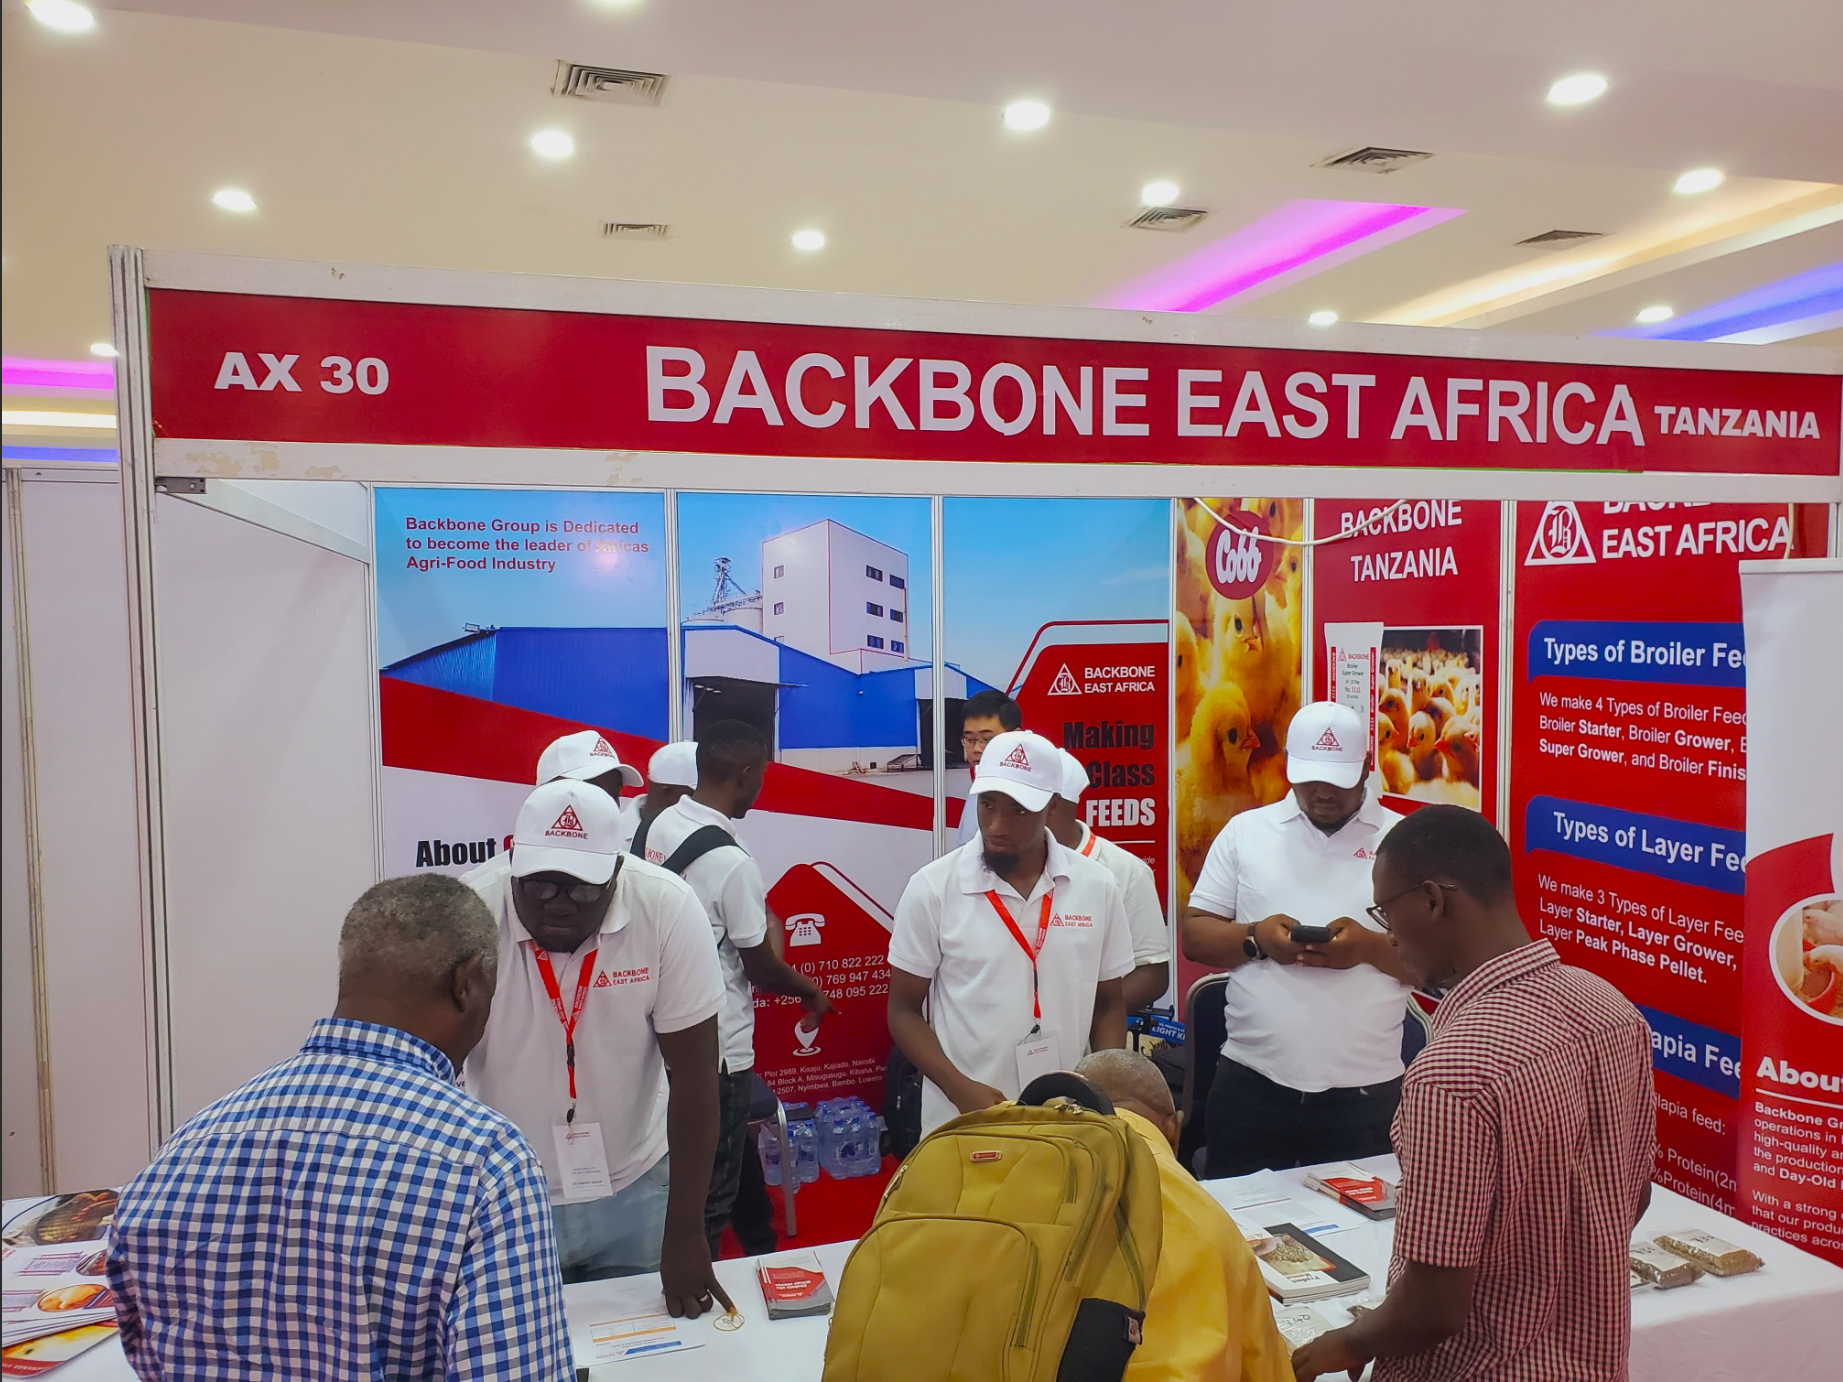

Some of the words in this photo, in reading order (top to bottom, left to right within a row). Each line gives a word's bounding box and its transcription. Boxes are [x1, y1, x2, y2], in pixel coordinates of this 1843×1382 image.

[213, 352, 302, 393] AX
[320, 356, 390, 396] 30
[646, 345, 1150, 437] BACKBONE
[1178, 368, 1376, 440] EAST
[1390, 376, 1646, 447] AFRICA
[1654, 405, 1821, 440] TANZANIA
[405, 517, 486, 532] Backbone
[491, 519, 541, 535] Group
[545, 520, 559, 534] is
[563, 520, 640, 535] Dedicated
[1340, 500, 1463, 538] BACKBONE
[406, 537, 422, 550] to
[427, 537, 491, 551] become
[495, 538, 519, 551] the
[525, 539, 573, 552] leader
[577, 540, 592, 552] of
[1602, 525, 1673, 559] EAST
[1675, 516, 1795, 556] AFRICA
[406, 556, 488, 572] Agri-Food
[492, 557, 557, 573] Industry
[1215, 526, 1262, 584] Cobb
[1350, 546, 1459, 583] TANZANIA
[1543, 637, 1599, 666] Types
[1604, 639, 1626, 663] of
[1630, 639, 1706, 667] Broiler
[1084, 665, 1156, 680] BACKBONE
[1084, 683, 1113, 694] EAST
[1114, 681, 1156, 693] AFRICA
[1539, 692, 1559, 708] We
[1561, 696, 1593, 711] make
[1595, 697, 1604, 711] 4
[1606, 697, 1645, 717] Types
[1647, 701, 1662, 717] of
[1663, 702, 1709, 722] Broiler
[1063, 720, 1155, 751] Making
[1539, 715, 1576, 733] Broiler
[1578, 719, 1626, 741] Starter,
[1628, 725, 1671, 745] Broiler
[1674, 729, 1735, 754] Grower,
[999, 761, 1032, 773] BACKBONE
[1539, 738, 1575, 757] Super
[1577, 743, 1628, 767] Grower,
[1631, 752, 1656, 769] and
[1659, 754, 1704, 776] Broiler
[1086, 761, 1155, 789] Class
[1086, 797, 1156, 828] FEEDS
[544, 830, 589, 840] BACKBONE
[1553, 810, 1610, 844] Types
[1614, 825, 1636, 849] of
[1641, 828, 1704, 864] Layer
[415, 837, 497, 868] About
[1538, 873, 1559, 892] We
[1560, 880, 1594, 902] make
[1597, 888, 1605, 905] 3
[1608, 892, 1648, 919] Types
[1651, 904, 1666, 922] of
[1668, 907, 1710, 934] Layer
[1064, 914, 1092, 922] BACKBONE
[1539, 897, 1574, 921] Layer
[1576, 906, 1626, 937] Starter,
[1628, 922, 1670, 949] Layer
[1673, 934, 1738, 971] Grower,
[801, 962, 816, 975] (0)
[819, 960, 839, 971] 710
[842, 957, 862, 969] 822
[865, 955, 885, 966] 222
[1539, 918, 1574, 943] Layer
[1576, 930, 1609, 953] Peak
[1611, 941, 1656, 967] Phase
[1659, 956, 1708, 984] Pellet.
[612, 967, 650, 979] BACKBONE
[613, 979, 629, 987] EAST
[826, 973, 846, 985] 769
[849, 971, 869, 983] 947
[872, 968, 892, 980] 434
[824, 988, 843, 1000] 748
[846, 986, 866, 998] 095
[869, 984, 889, 995] 222
[764, 1070, 778, 1078] Plot
[852, 1057, 876, 1067] Nairobi
[778, 1076, 797, 1086] Block
[858, 1074, 883, 1084] Luwero
[1756, 1055, 1843, 1094] Abou
[1691, 1108, 1726, 1136] feed:
[1754, 1101, 1823, 1127] Backbone
[1754, 1118, 1821, 1141] operations
[1825, 1131, 1837, 1144] in
[1754, 1131, 1828, 1159] high-quality
[1753, 1146, 1772, 1160] the
[1775, 1154, 1843, 1175] production
[1753, 1162, 1776, 1177] and
[1779, 1167, 1837, 1189] Day-Old
[1752, 1189, 1779, 1208] With
[1783, 1200, 1792, 1210] a
[1795, 1201, 1837, 1221] strong
[1751, 1205, 1775, 1221] that
[1778, 1214, 1800, 1226] our
[1803, 1217, 1843, 1236] produ
[1751, 1222, 1808, 1243] practices
